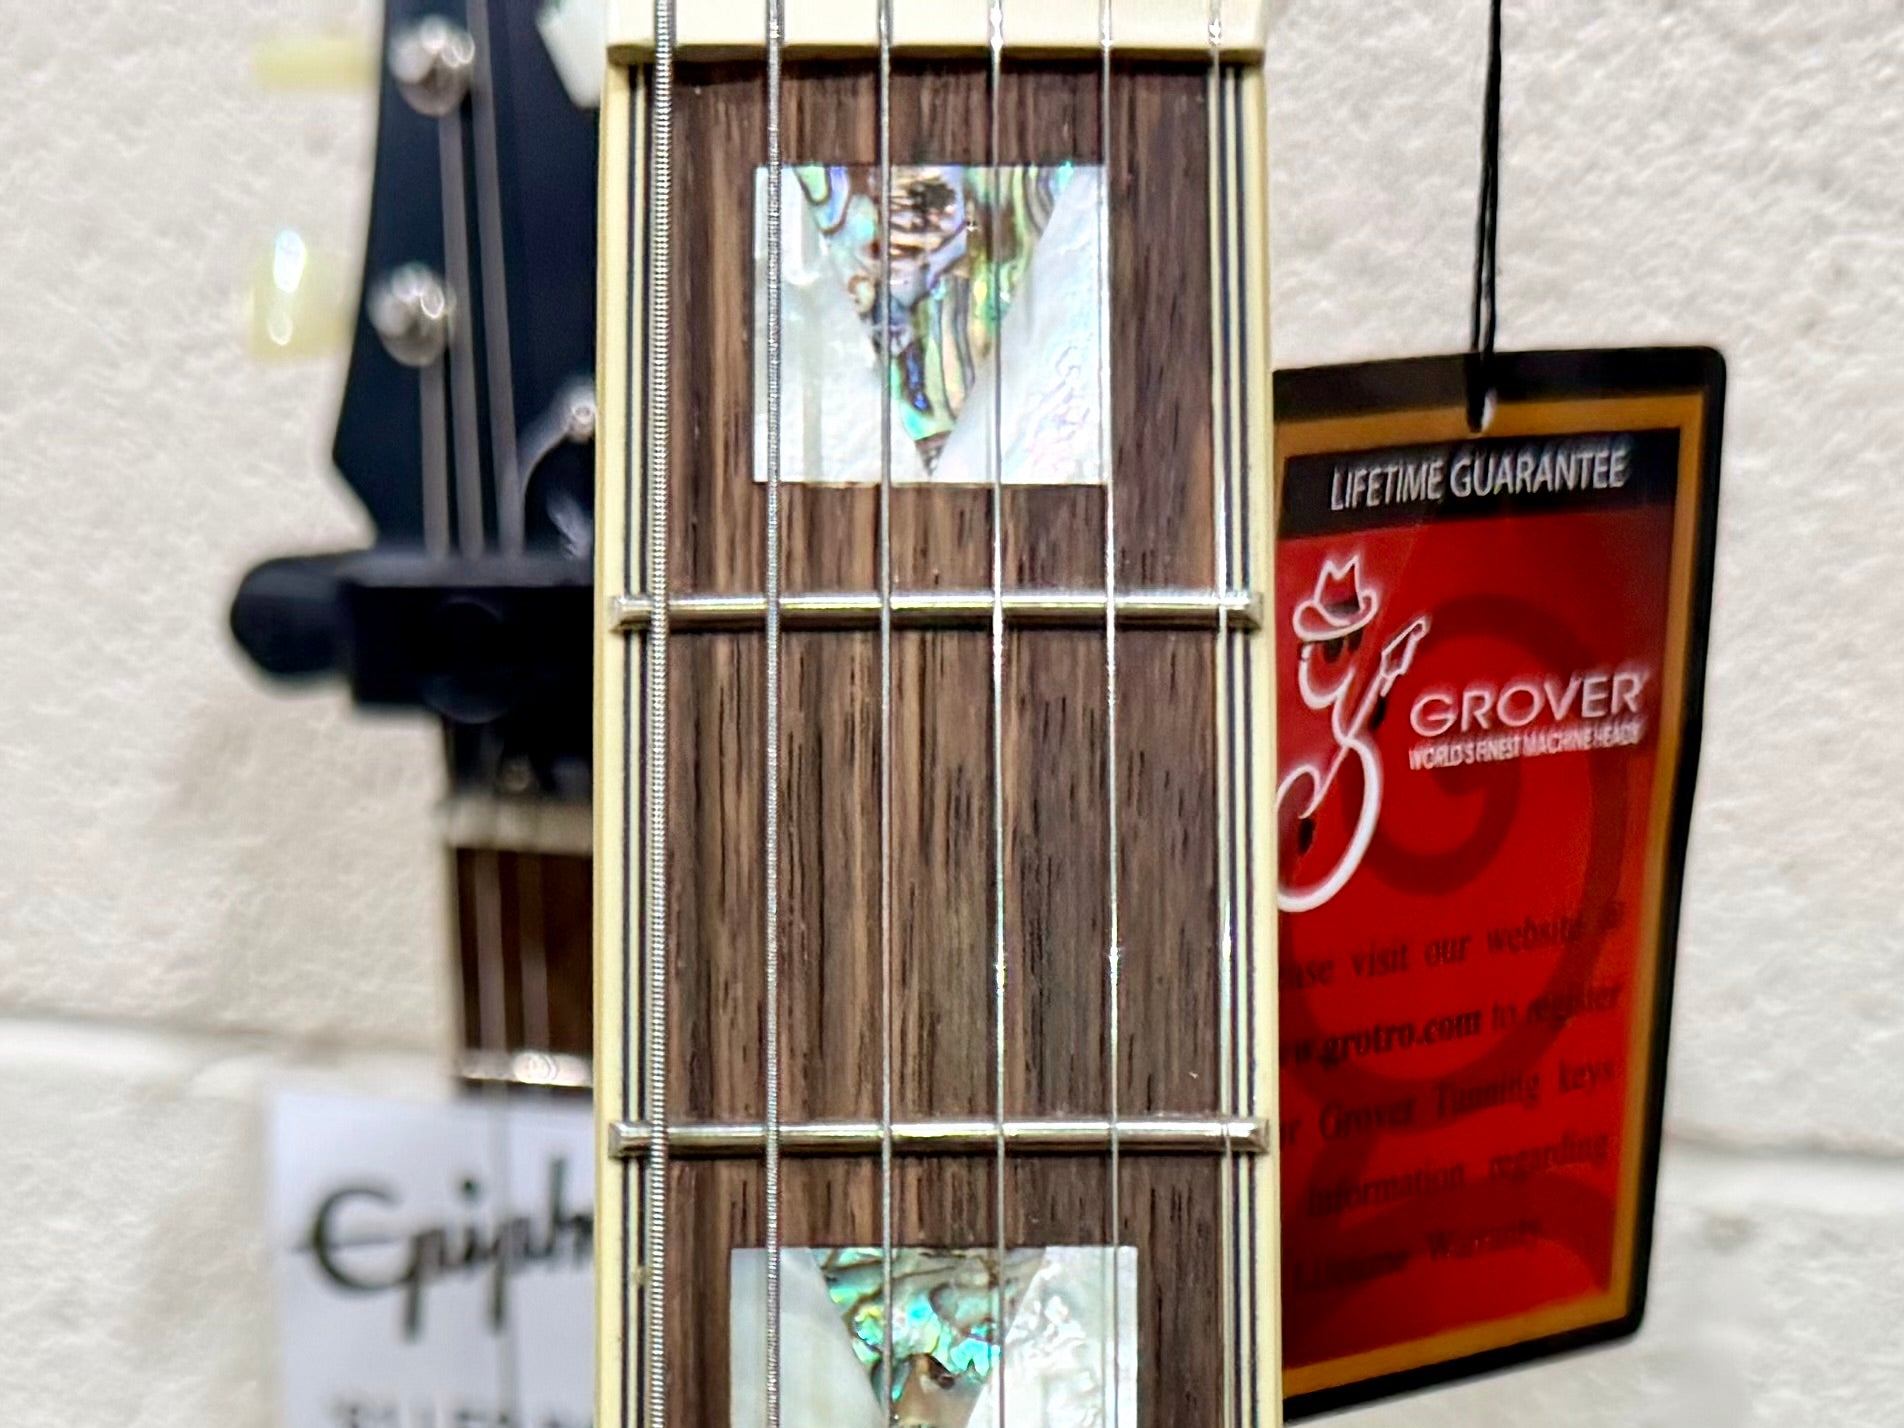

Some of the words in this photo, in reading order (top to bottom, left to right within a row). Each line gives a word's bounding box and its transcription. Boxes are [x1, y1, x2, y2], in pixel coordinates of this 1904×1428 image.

[1331, 460, 1445, 510] LIFETIME
[1450, 450, 1632, 497] GUARANTEE
[1410, 671, 1647, 737] GROVER
[1352, 939, 1409, 977] visit
[1424, 934, 1471, 968] our
[299, 1157, 593, 1342] Epiph
